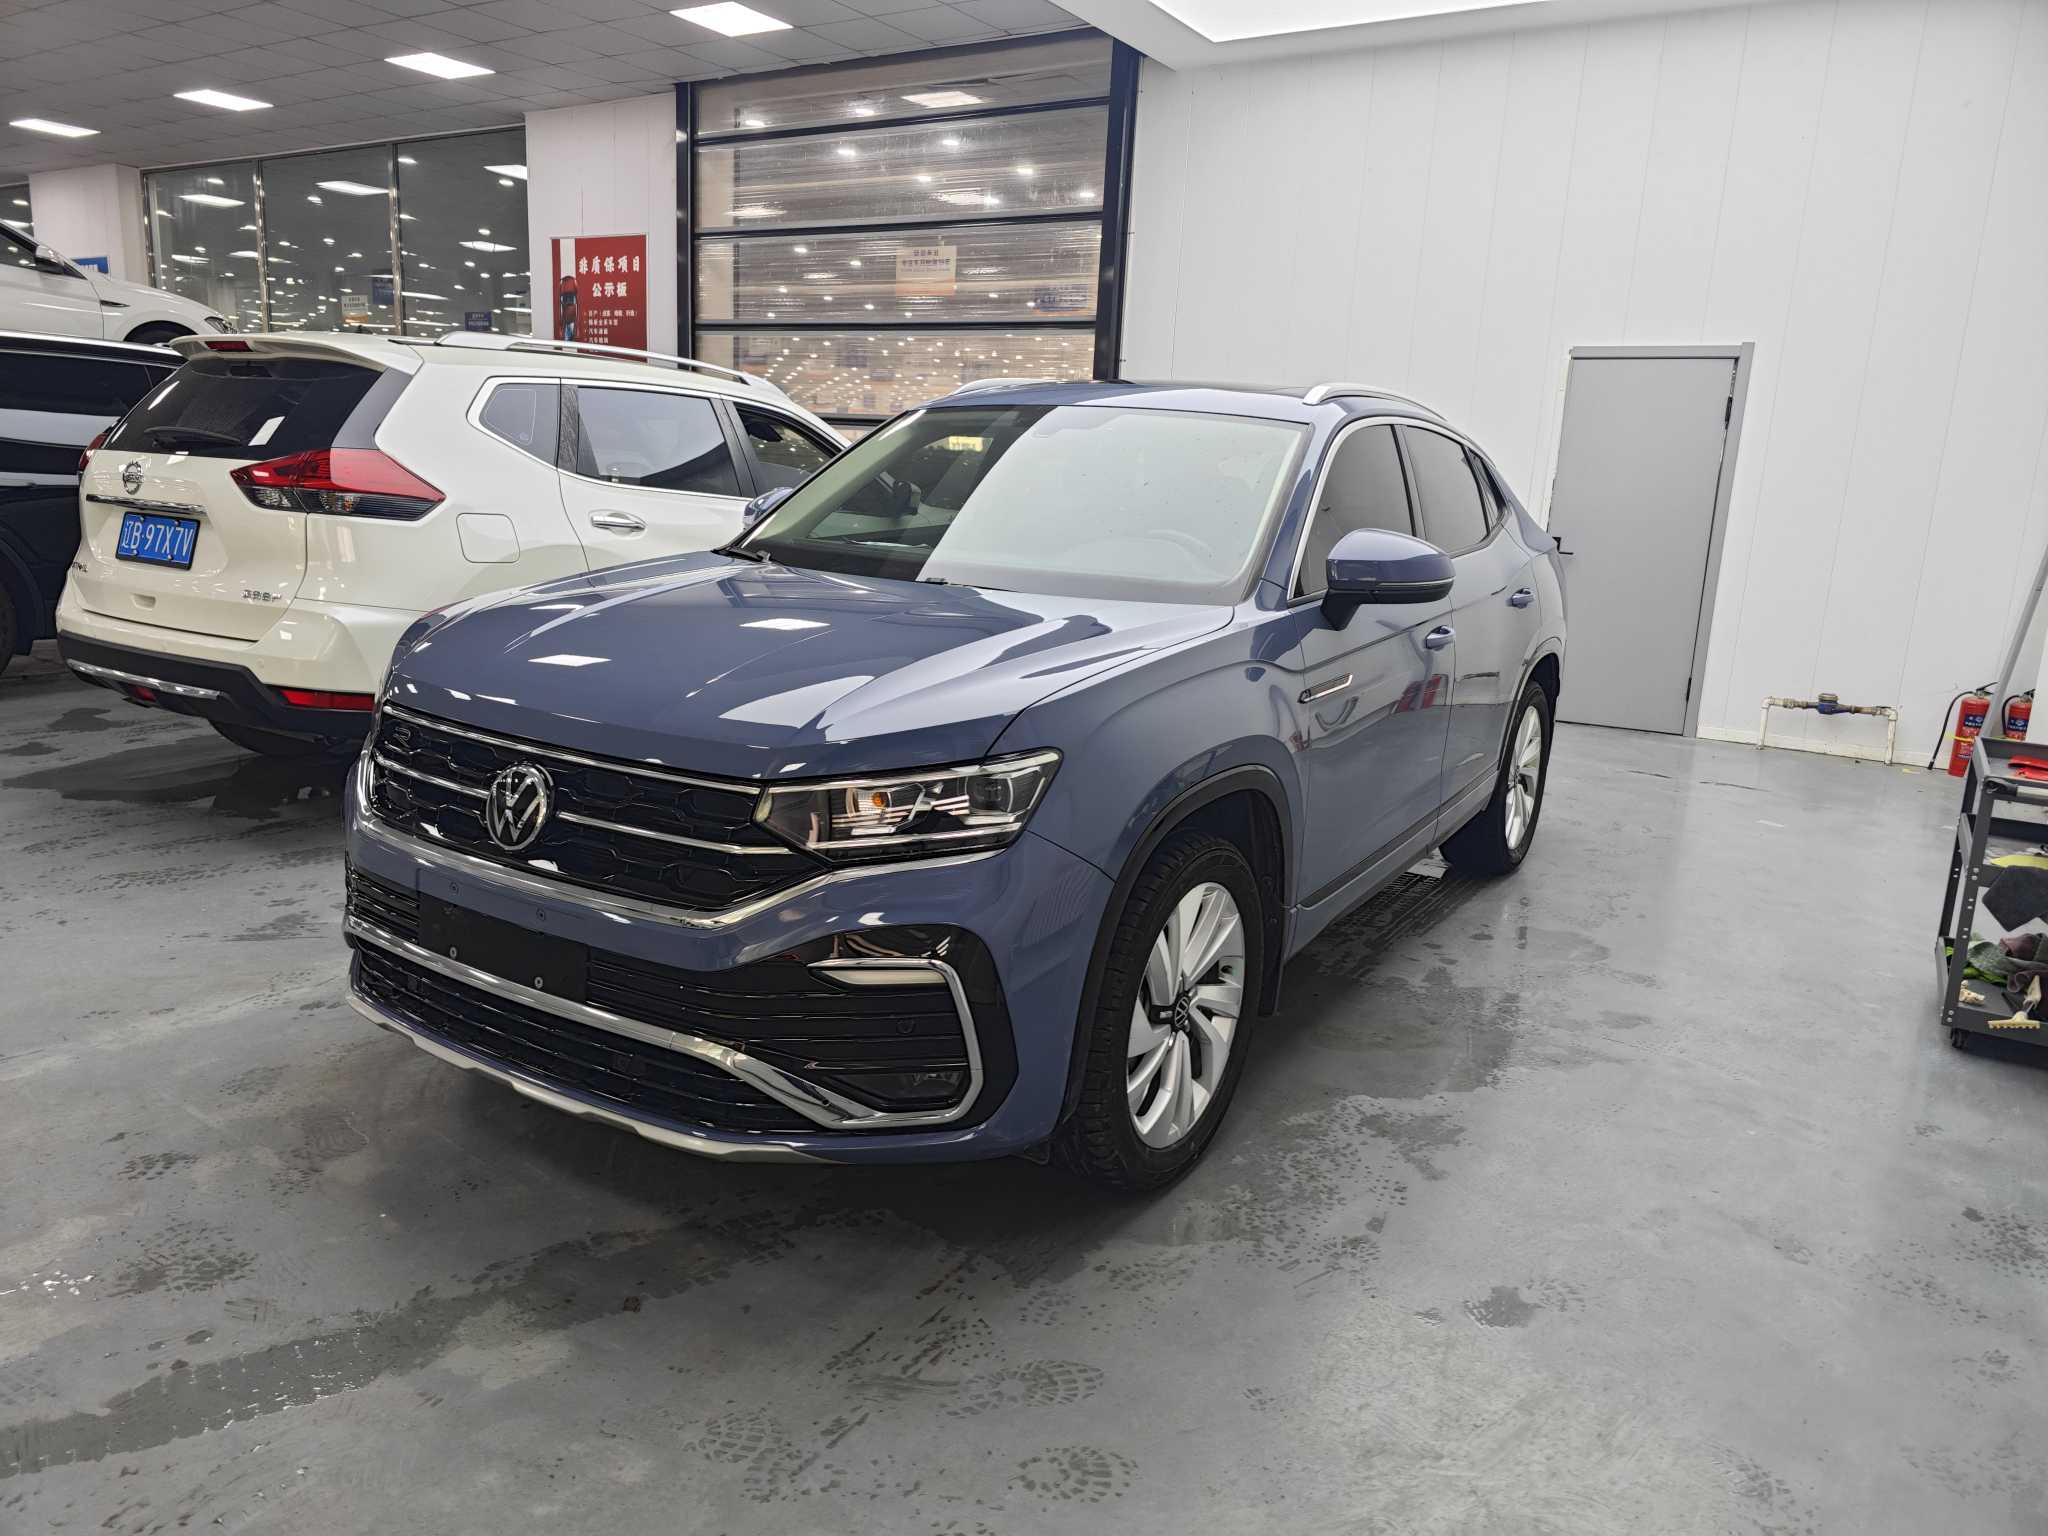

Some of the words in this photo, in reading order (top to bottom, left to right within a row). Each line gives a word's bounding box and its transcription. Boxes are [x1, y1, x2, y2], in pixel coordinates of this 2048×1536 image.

[579, 255, 640, 275] 非质保项目
[592, 282, 628, 298] 公示板
[121, 520, 194, 557] 辽B·97X7V
